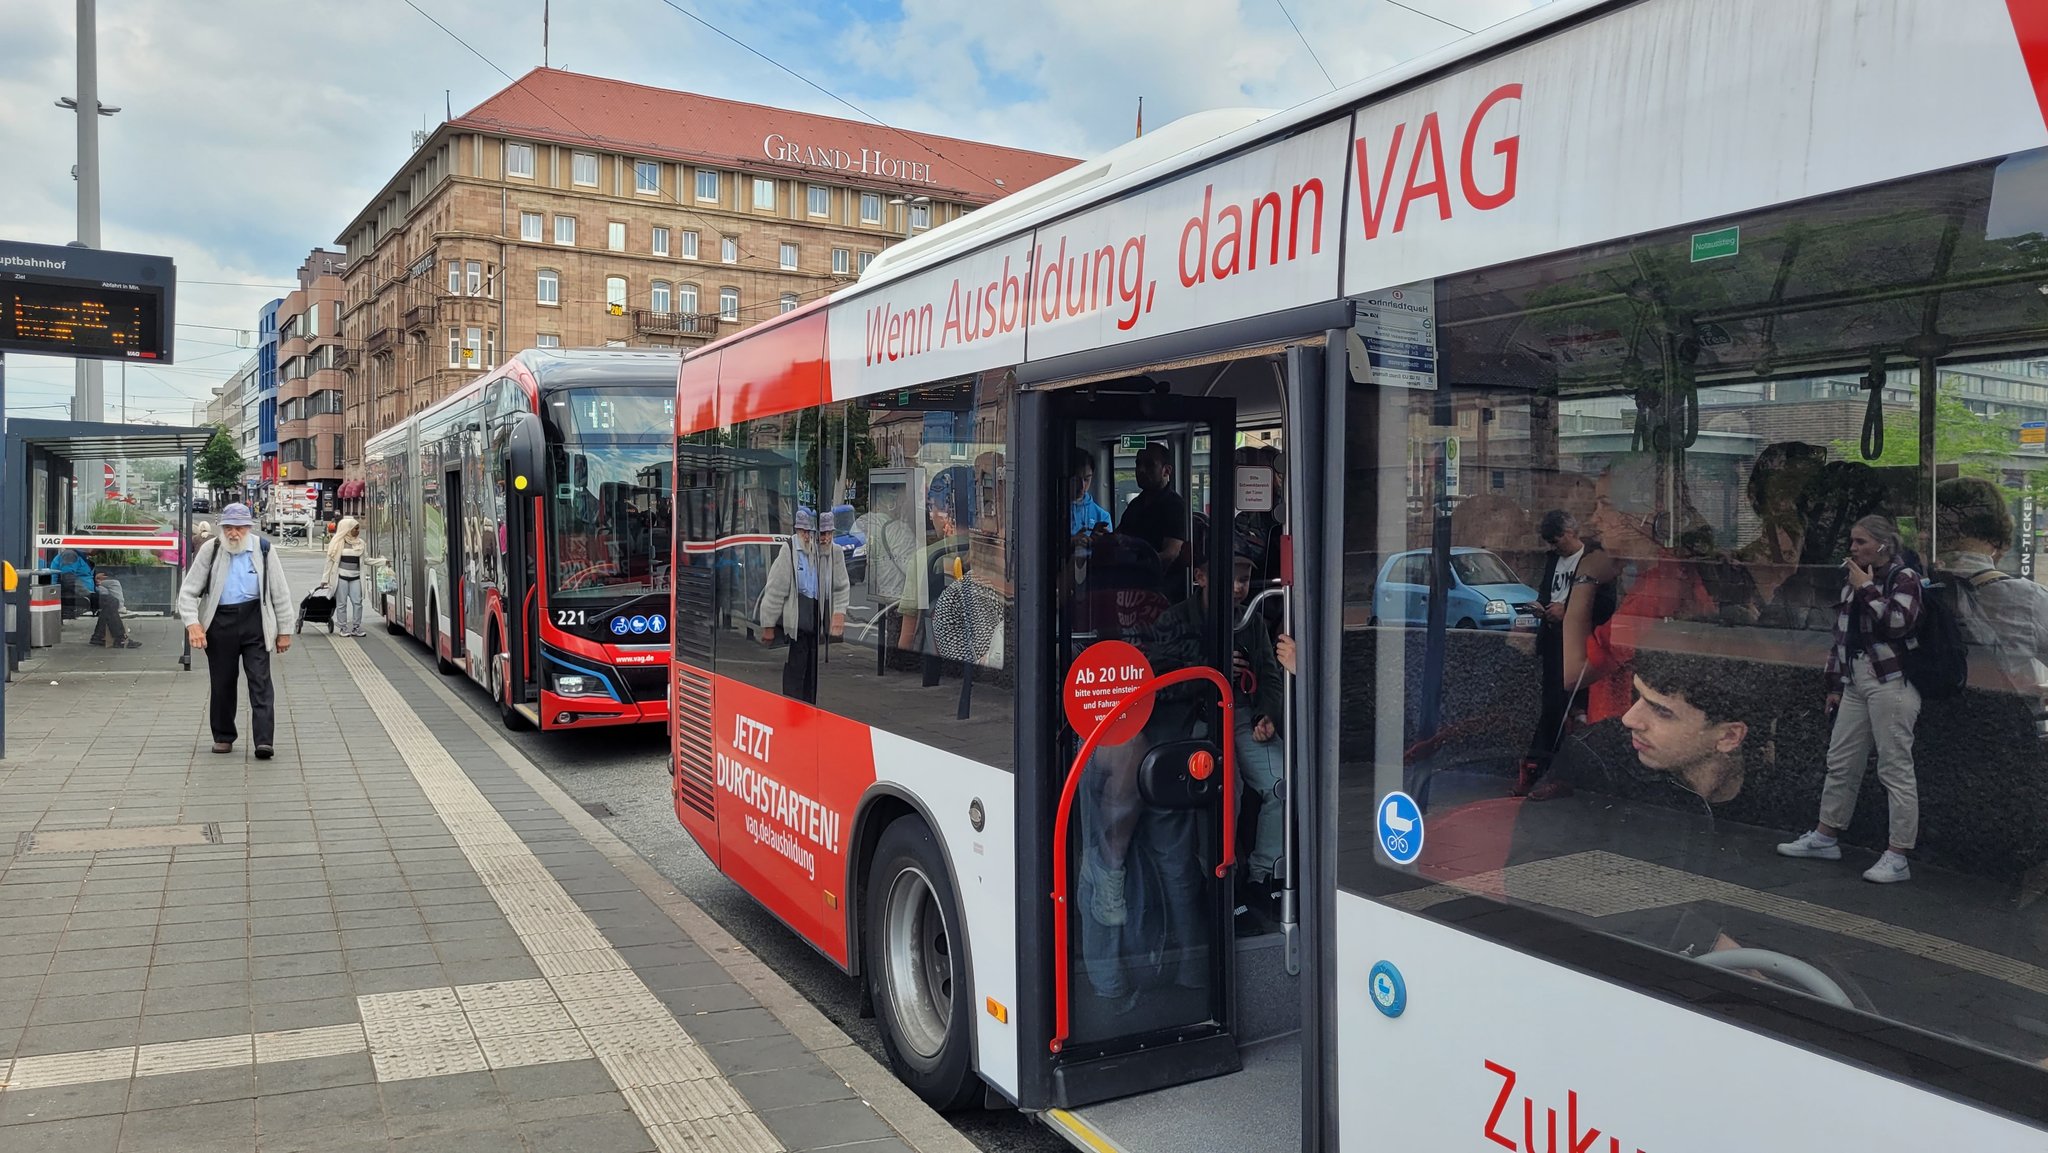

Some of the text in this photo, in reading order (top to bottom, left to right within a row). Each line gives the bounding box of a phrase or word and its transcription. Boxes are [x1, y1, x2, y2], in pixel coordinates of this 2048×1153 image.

[866, 82, 1523, 367] Wenn Ausbildung, dann VAG
[101, 281, 122, 290] Abfahrt
[41, 537, 61, 545] VAG
[557, 610, 585, 625] 221
[616, 654, 655, 664] www.vag.de
[1075, 664, 1145, 685] Ab 20 Uhr
[1075, 688, 1092, 698] bitte
[1092, 688, 1111, 697] vorne
[1083, 701, 1097, 710] und
[733, 713, 774, 763] JETZT
[717, 752, 840, 854] DURCHSTARTEN!
[745, 813, 815, 881] vag.de/ausbildung
[1484, 1058, 1647, 1153] Zuk
